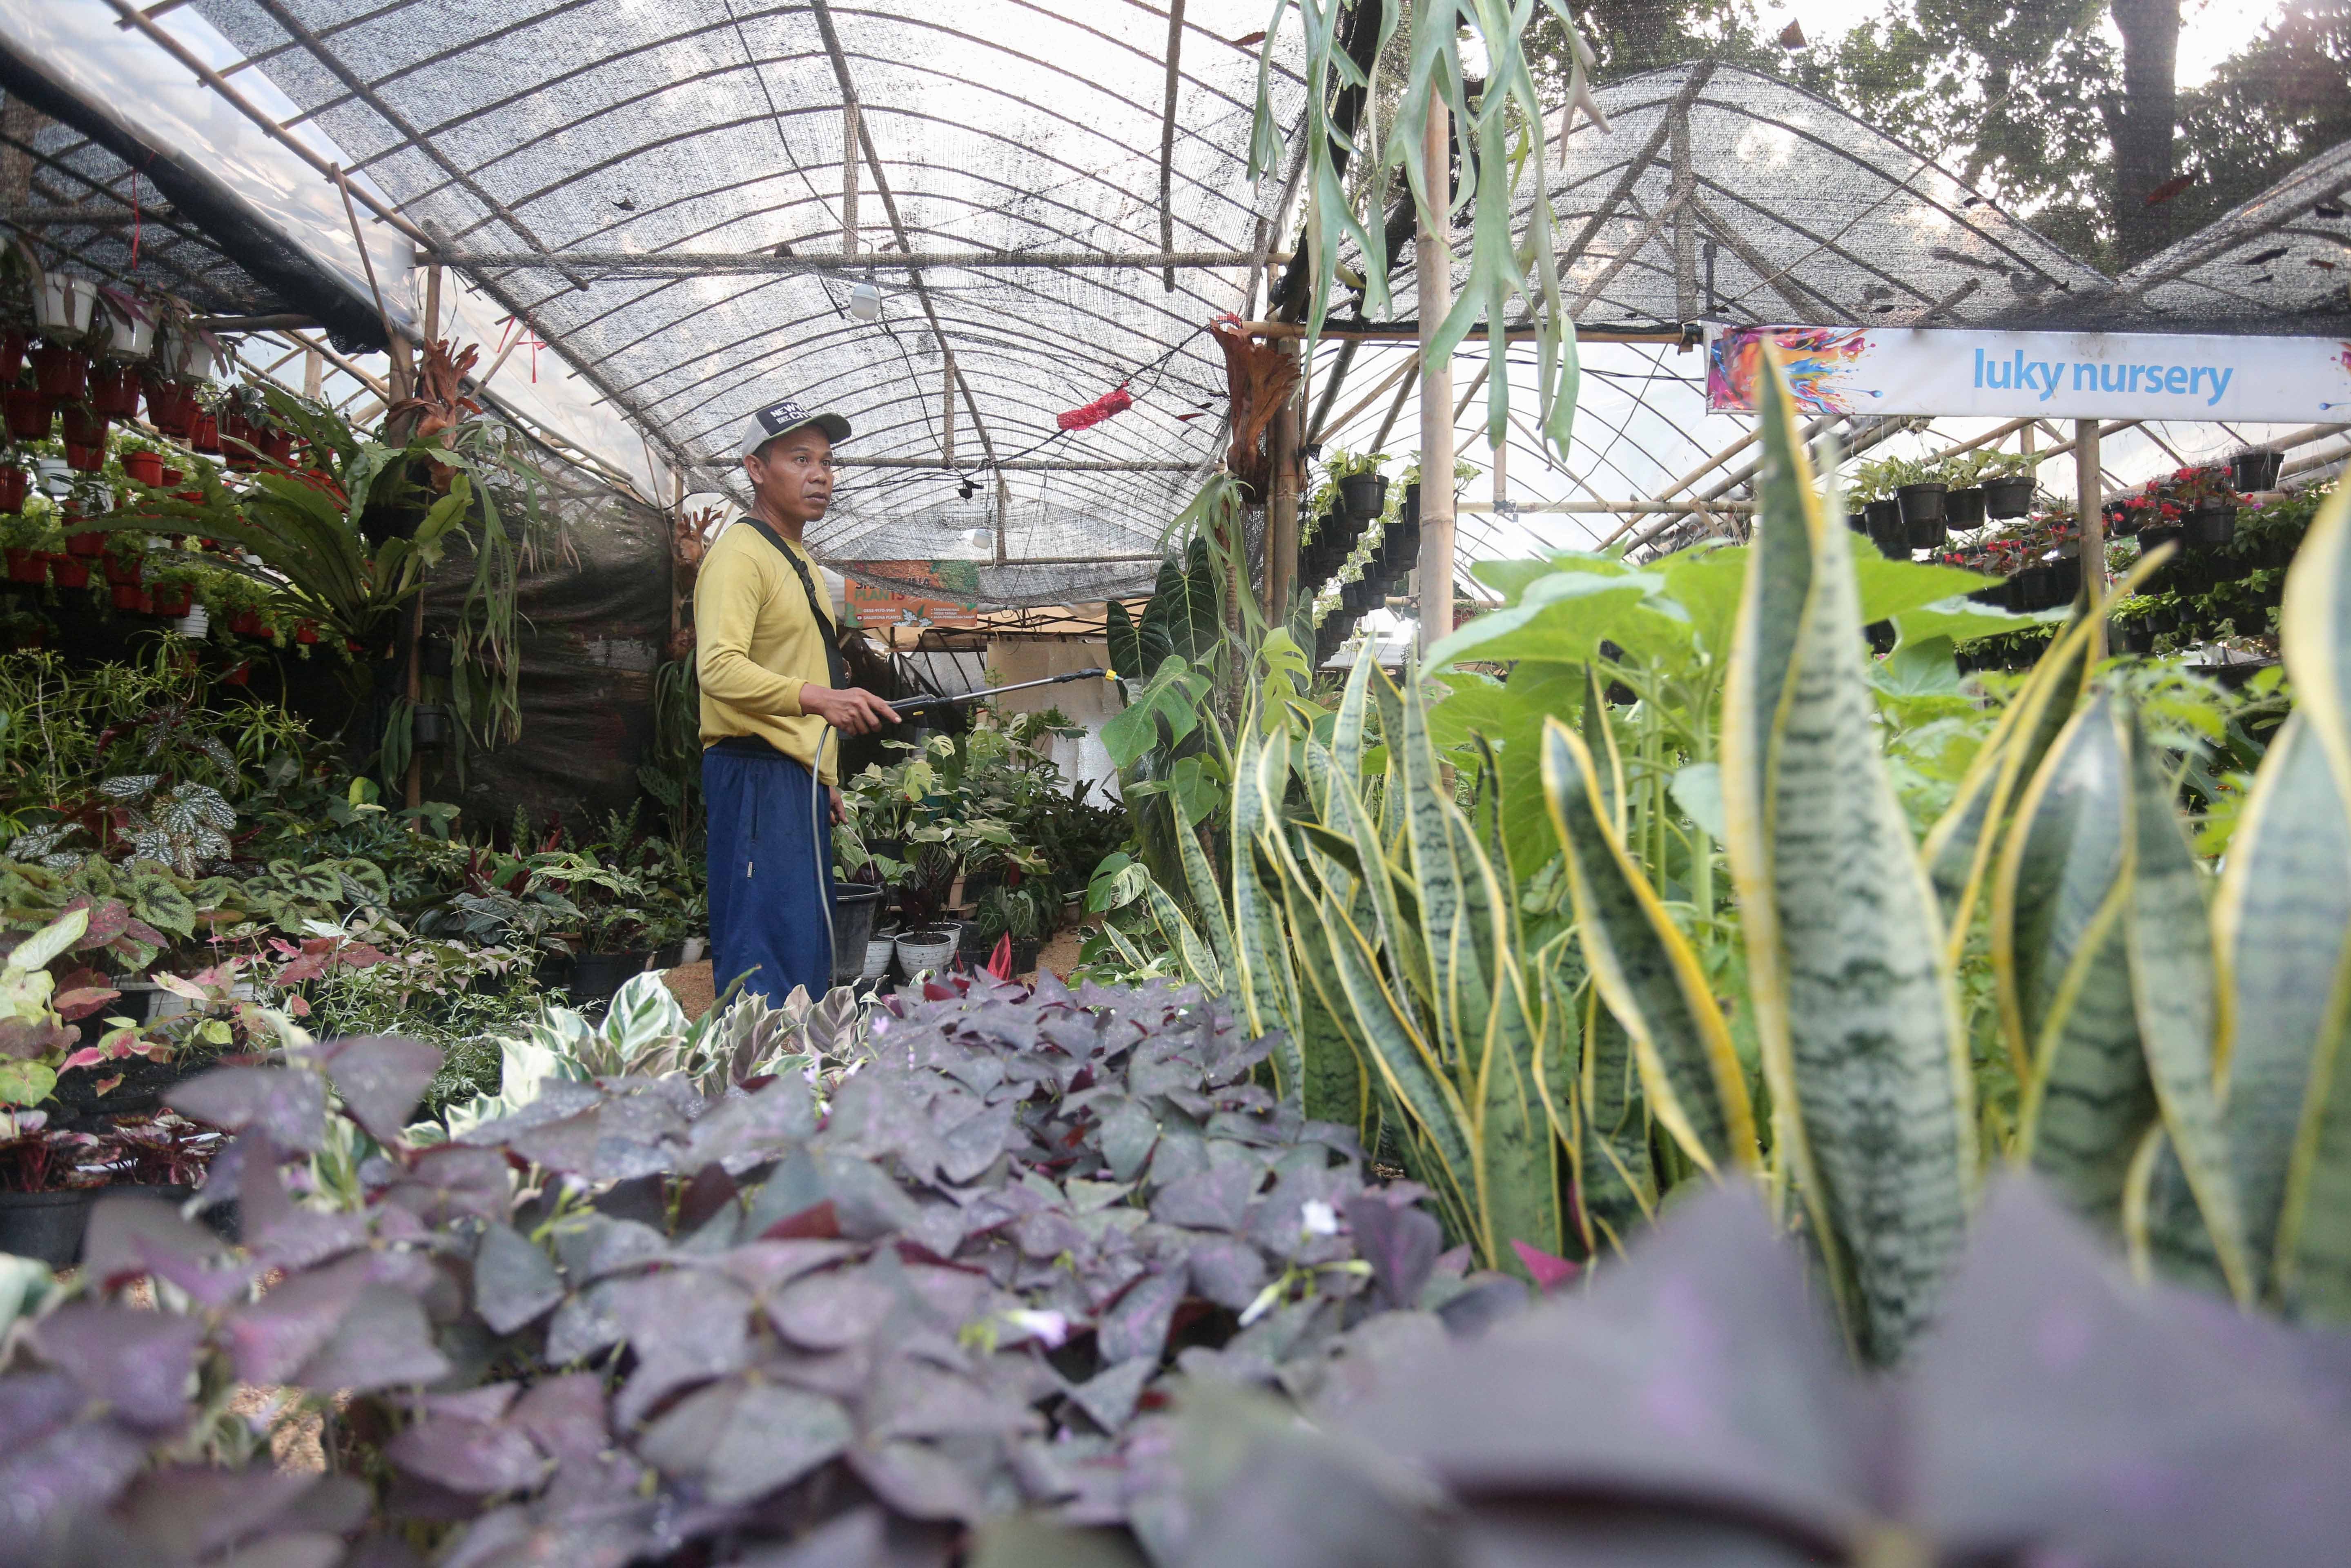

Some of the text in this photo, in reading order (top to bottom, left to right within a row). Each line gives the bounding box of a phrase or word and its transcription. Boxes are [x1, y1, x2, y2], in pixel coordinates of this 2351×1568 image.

[1974, 348, 2234, 406] luky nursery
[770, 403, 796, 417] NEW
